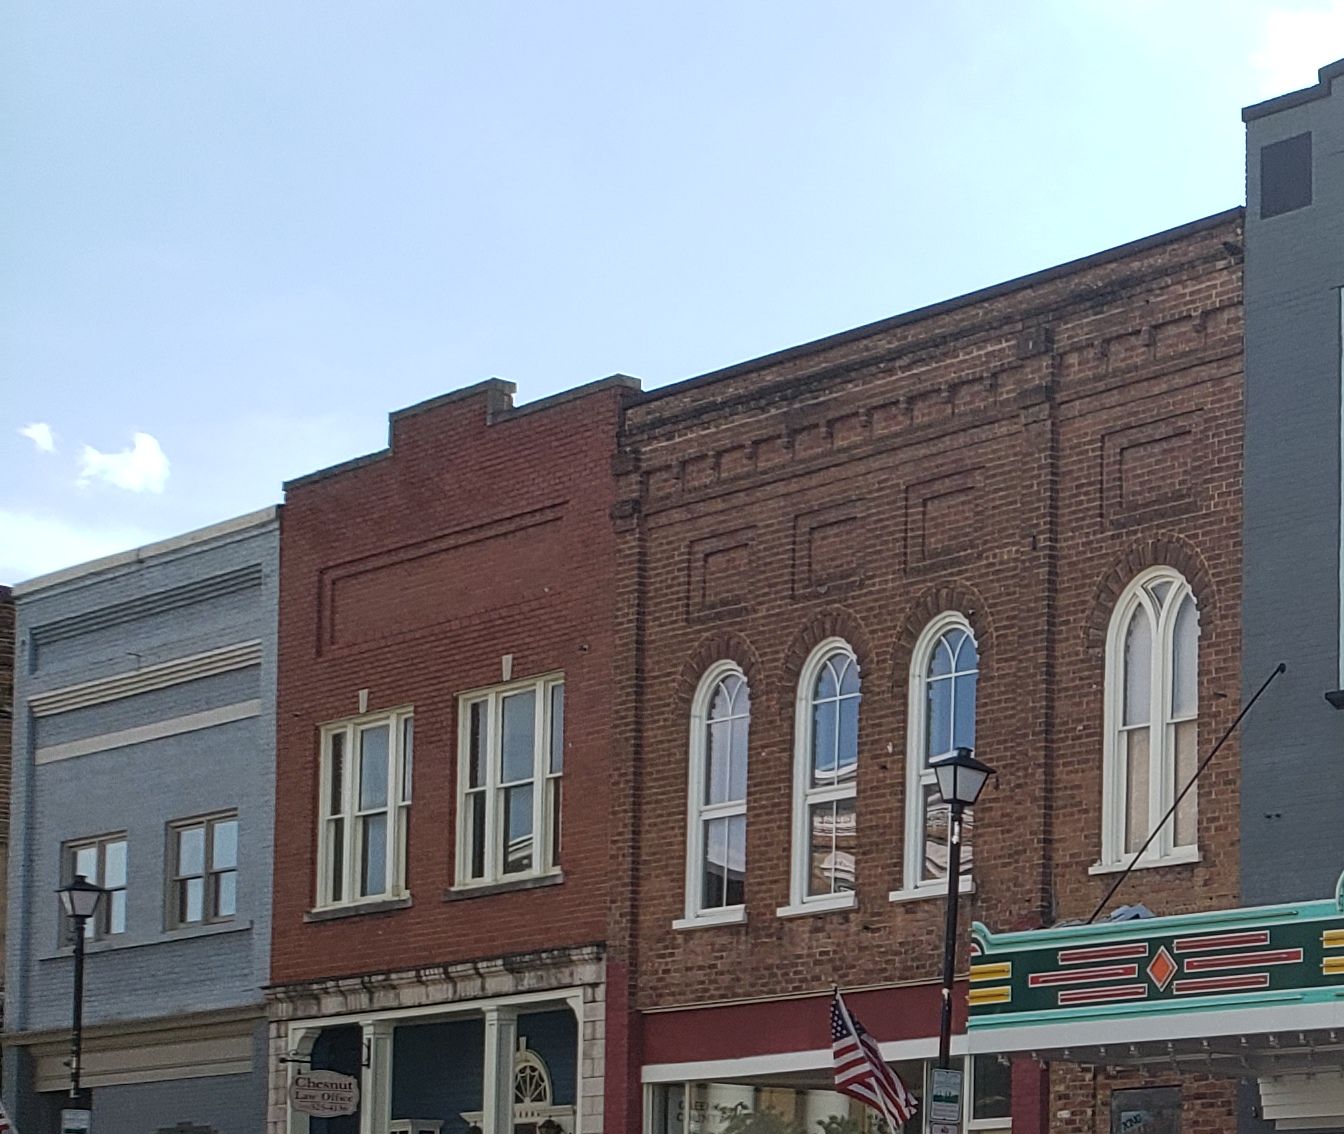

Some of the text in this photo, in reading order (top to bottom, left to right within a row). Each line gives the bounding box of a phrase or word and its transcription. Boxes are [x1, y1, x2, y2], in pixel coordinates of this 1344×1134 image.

[295, 1077, 353, 1090] Chesnut
[295, 1091, 353, 1103] Law Office
